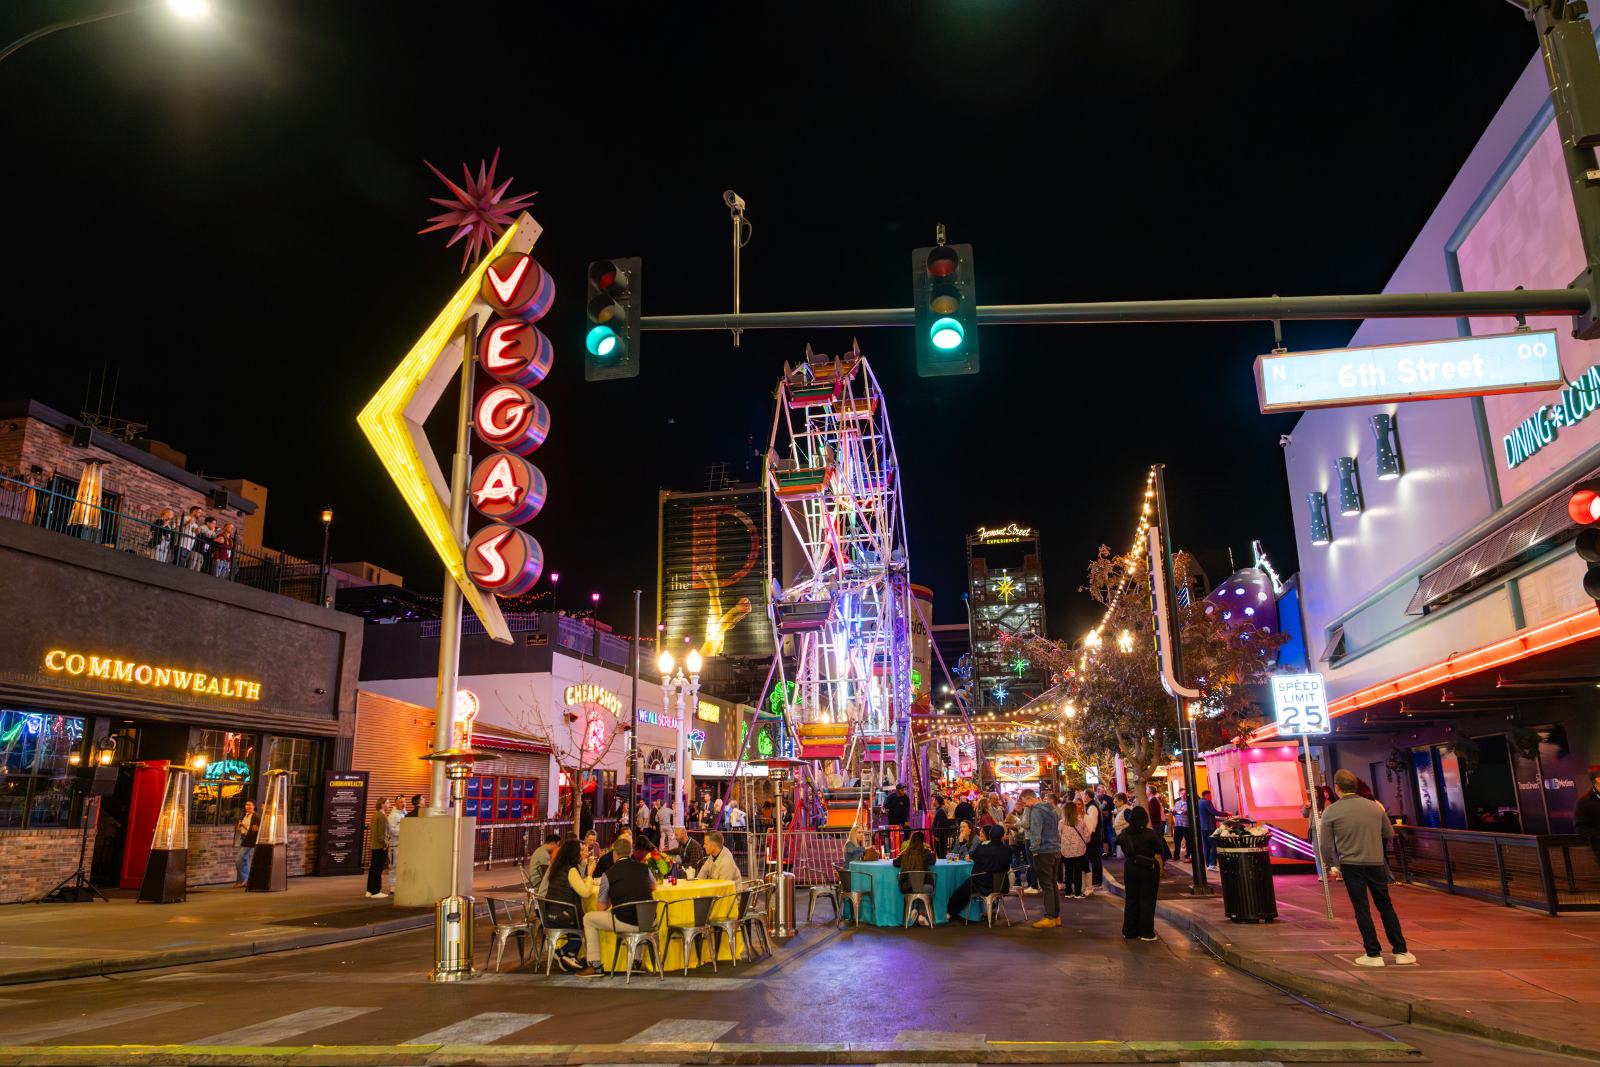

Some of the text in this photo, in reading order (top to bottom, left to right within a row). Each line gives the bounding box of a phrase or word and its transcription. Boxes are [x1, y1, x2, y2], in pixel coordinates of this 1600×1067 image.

[1272, 364, 1287, 381] N
[1338, 363, 1386, 388] 6th
[1398, 352, 1485, 384] Street
[470, 254, 534, 588] VEGAS
[1503, 404, 1552, 470] DINING
[977, 523, 1031, 542] Fremont Street
[986, 537, 1020, 545] EXPERIENCE
[45, 650, 262, 700] COMMONWEALTH
[1278, 681, 1319, 692] SPEED
[1283, 693, 1315, 704] LIMIT
[638, 709, 648, 723] WE
[648, 711, 658, 726] ALL
[1282, 705, 1323, 728] 25
[717, 761, 733, 769] SALES
